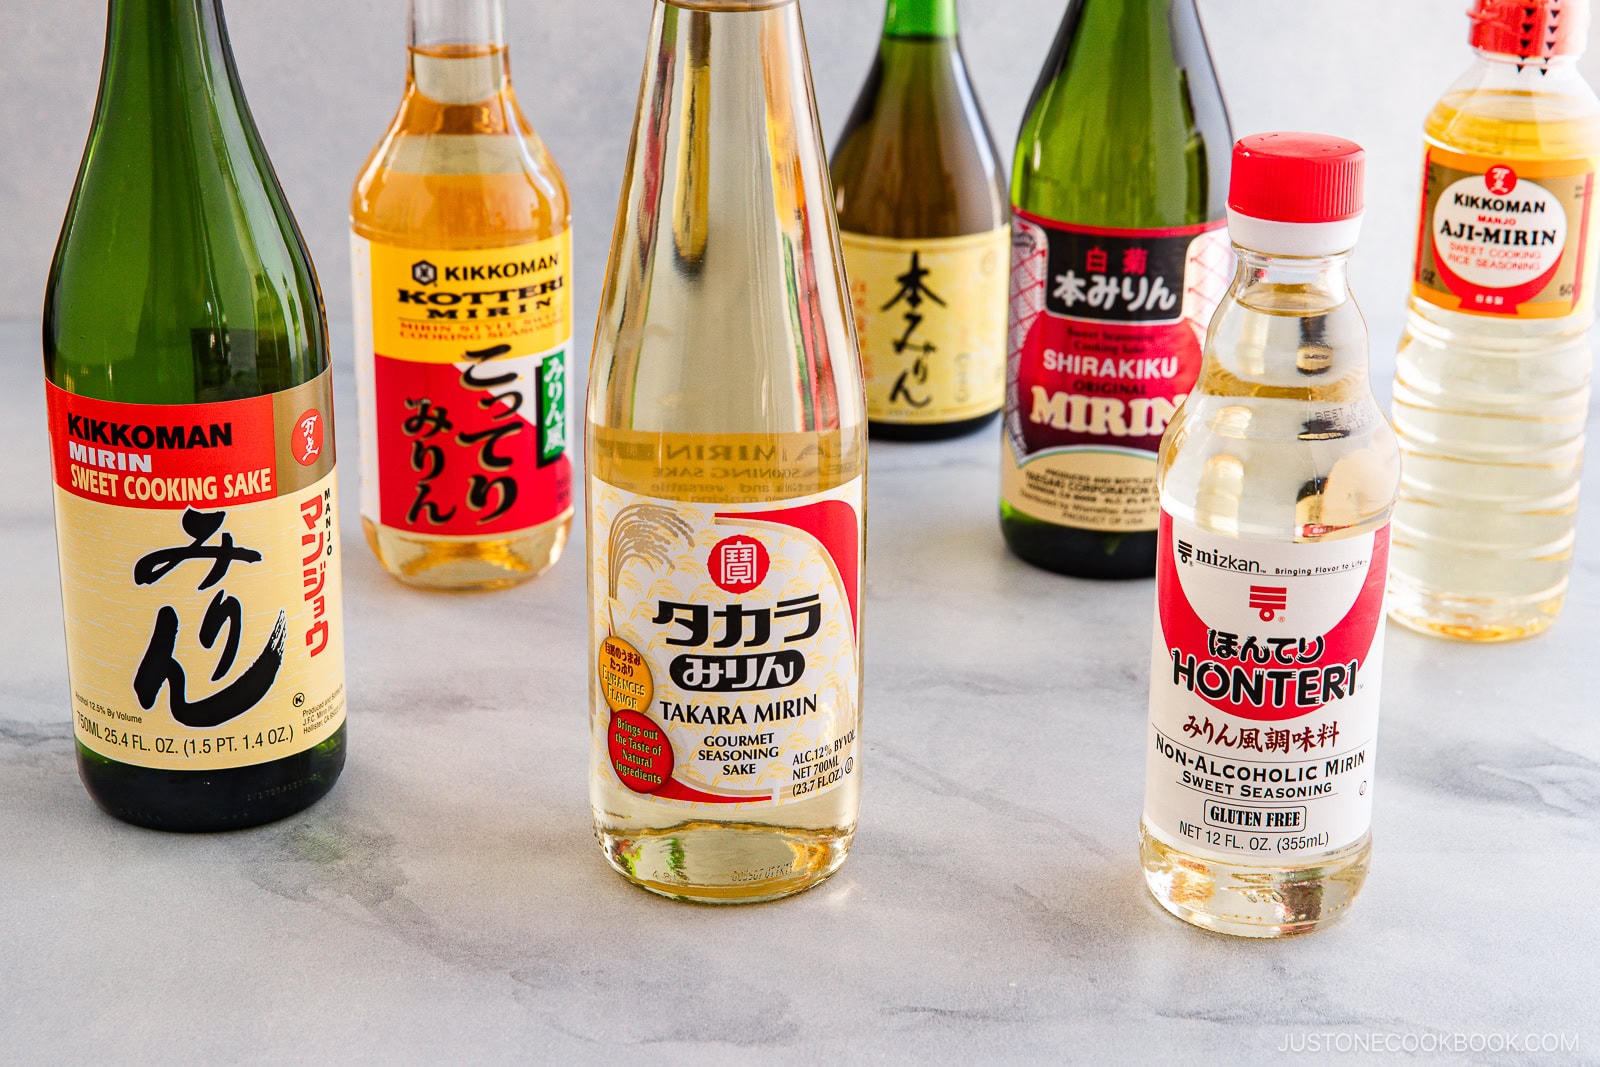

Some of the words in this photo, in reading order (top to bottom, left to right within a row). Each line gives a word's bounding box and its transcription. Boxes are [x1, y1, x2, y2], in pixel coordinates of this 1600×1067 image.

[1454, 192, 1546, 213] KIKKOMAN
[1440, 219, 1557, 246] AJI-MIRIN
[1478, 215, 1516, 226] MANJO
[1447, 253, 1470, 266] RICE
[1476, 257, 1541, 271] SEASONING
[1450, 242, 1484, 257] SWEET
[1489, 247, 1542, 260] COOKING
[445, 252, 559, 282] KIKKOMAN
[397, 275, 564, 306] KOTTERI
[1053, 269, 1177, 312] 本みりん
[427, 297, 552, 320] MIRIN
[400, 321, 451, 333] MIRIN
[459, 321, 513, 333] STYLE
[400, 330, 482, 342] COOKING
[880, 250, 947, 407] 本みりん
[1043, 349, 1179, 379] SHIRAKIKU
[1073, 379, 1146, 396] ORIGINAL
[543, 357, 566, 454] みりん風
[67, 412, 232, 450] KIKKOMAN
[457, 344, 524, 525] こってり
[68, 440, 152, 473] MIRIN
[402, 397, 456, 525] みりん
[70, 463, 119, 498] SWEET
[123, 476, 218, 502] COOKING
[224, 467, 272, 498] SAKE
[324, 487, 333, 557] MANJO
[300, 494, 329, 658] マンジョウ
[1275, 567, 1312, 577] Bringing
[1315, 565, 1339, 575] Flavor
[133, 508, 286, 727] みりん
[652, 593, 822, 648] タカラ
[1208, 629, 1324, 664] ほんてり
[602, 664, 646, 697] ENHANCES
[682, 655, 794, 689] みりん
[1172, 650, 1359, 707] HONTERI
[75, 690, 89, 706] Alcohol
[89, 700, 106, 716] 12.5%
[107, 708, 116, 720] By
[115, 710, 143, 724] Volume
[303, 701, 324, 717] Produced
[607, 683, 638, 711] FLAVOR
[659, 700, 748, 725] TAKARA
[754, 694, 817, 724] MIRIN
[76, 710, 103, 740] 750ML
[104, 727, 129, 748] 25.4
[132, 734, 151, 752] FL.
[155, 737, 178, 754] OZ.
[183, 738, 211, 758] (1.5
[216, 736, 238, 753] PT.
[243, 731, 264, 750] 1.4
[268, 724, 294, 745] OZ.)
[617, 717, 642, 737] Brings
[643, 728, 659, 741] out
[703, 732, 775, 747] GOURMET
[1182, 715, 1340, 753] みりん風調味料
[615, 732, 627, 746] the
[628, 737, 650, 754] Taste
[652, 745, 663, 757] of
[621, 748, 653, 769] Natural
[698, 746, 780, 762] SEASONING
[834, 737, 844, 753] BY
[616, 759, 663, 785] Ingredients
[722, 763, 757, 777] SAKE
[792, 765, 812, 781] NET
[813, 755, 839, 776] 700ML
[1325, 750, 1365, 778] MIRIN
[792, 779, 815, 798] (23.7
[1182, 771, 1235, 795] SWEET
[1240, 782, 1332, 800] SEASONING
[1210, 805, 1262, 827] GLUTEN
[1266, 810, 1300, 827] FREE
[1179, 820, 1202, 841] NET
[1206, 830, 1221, 846] 12
[1224, 833, 1244, 849] FL.
[1249, 836, 1272, 851] OZ.
[1276, 831, 1329, 853] (355mL)
